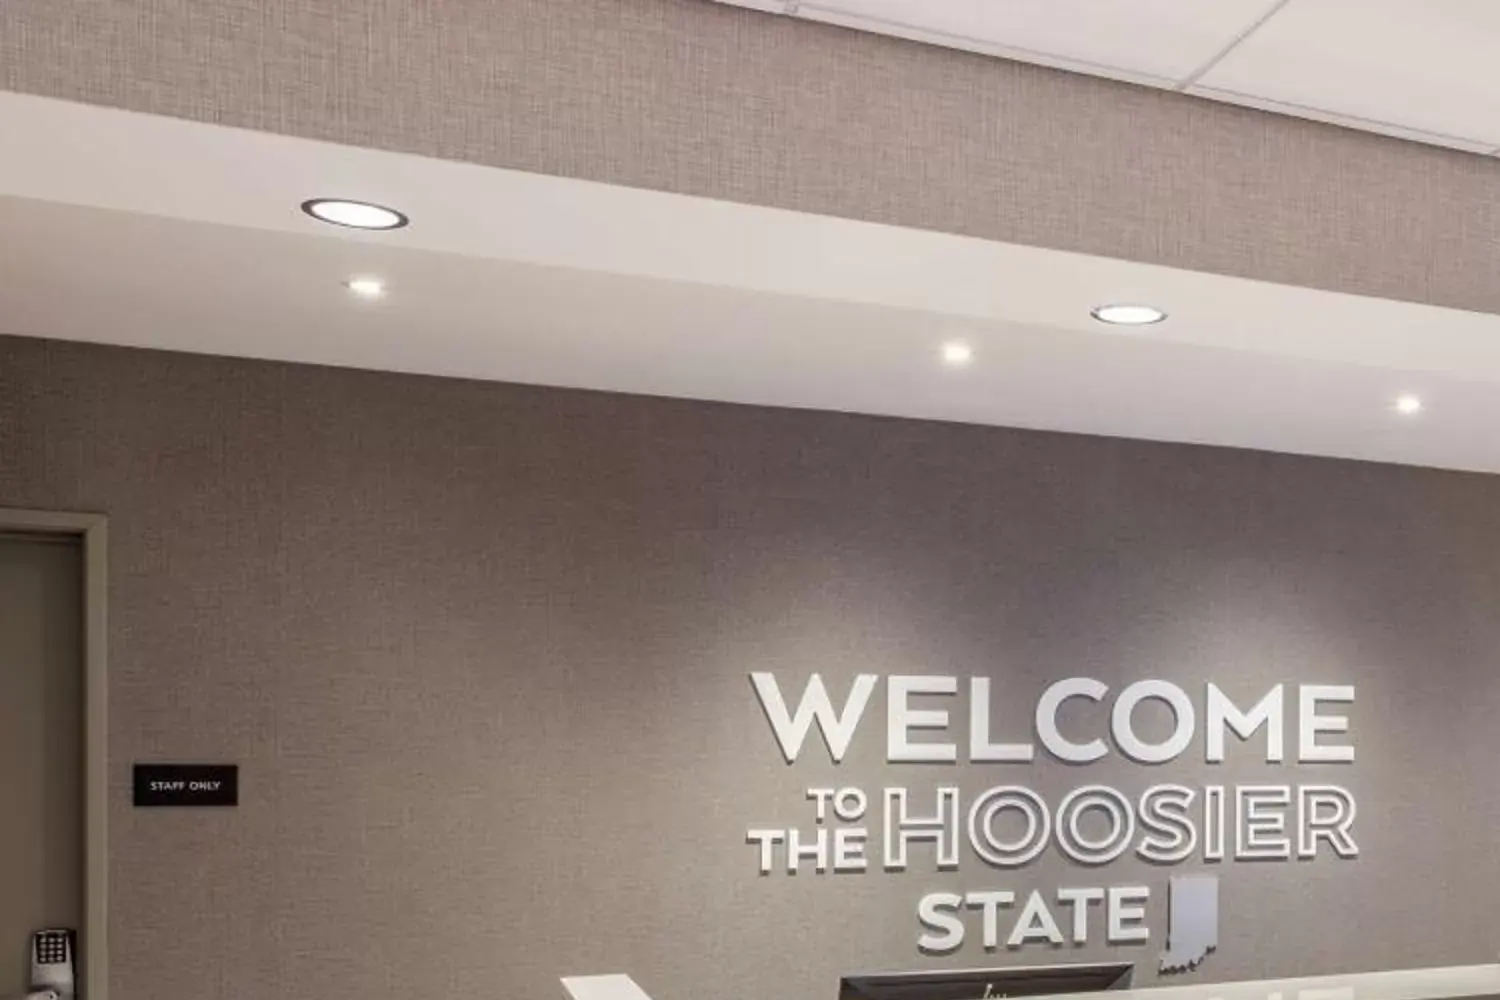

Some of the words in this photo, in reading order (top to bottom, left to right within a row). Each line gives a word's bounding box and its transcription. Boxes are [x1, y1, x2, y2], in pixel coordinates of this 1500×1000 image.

[750, 672, 1356, 764] WELCOME
[150, 781, 185, 792] STAFF
[189, 781, 221, 792] ONLY
[806, 787, 867, 822] TO
[746, 828, 867, 873] THE
[883, 784, 1359, 870] HOOSIER
[917, 886, 1150, 953] STATE
